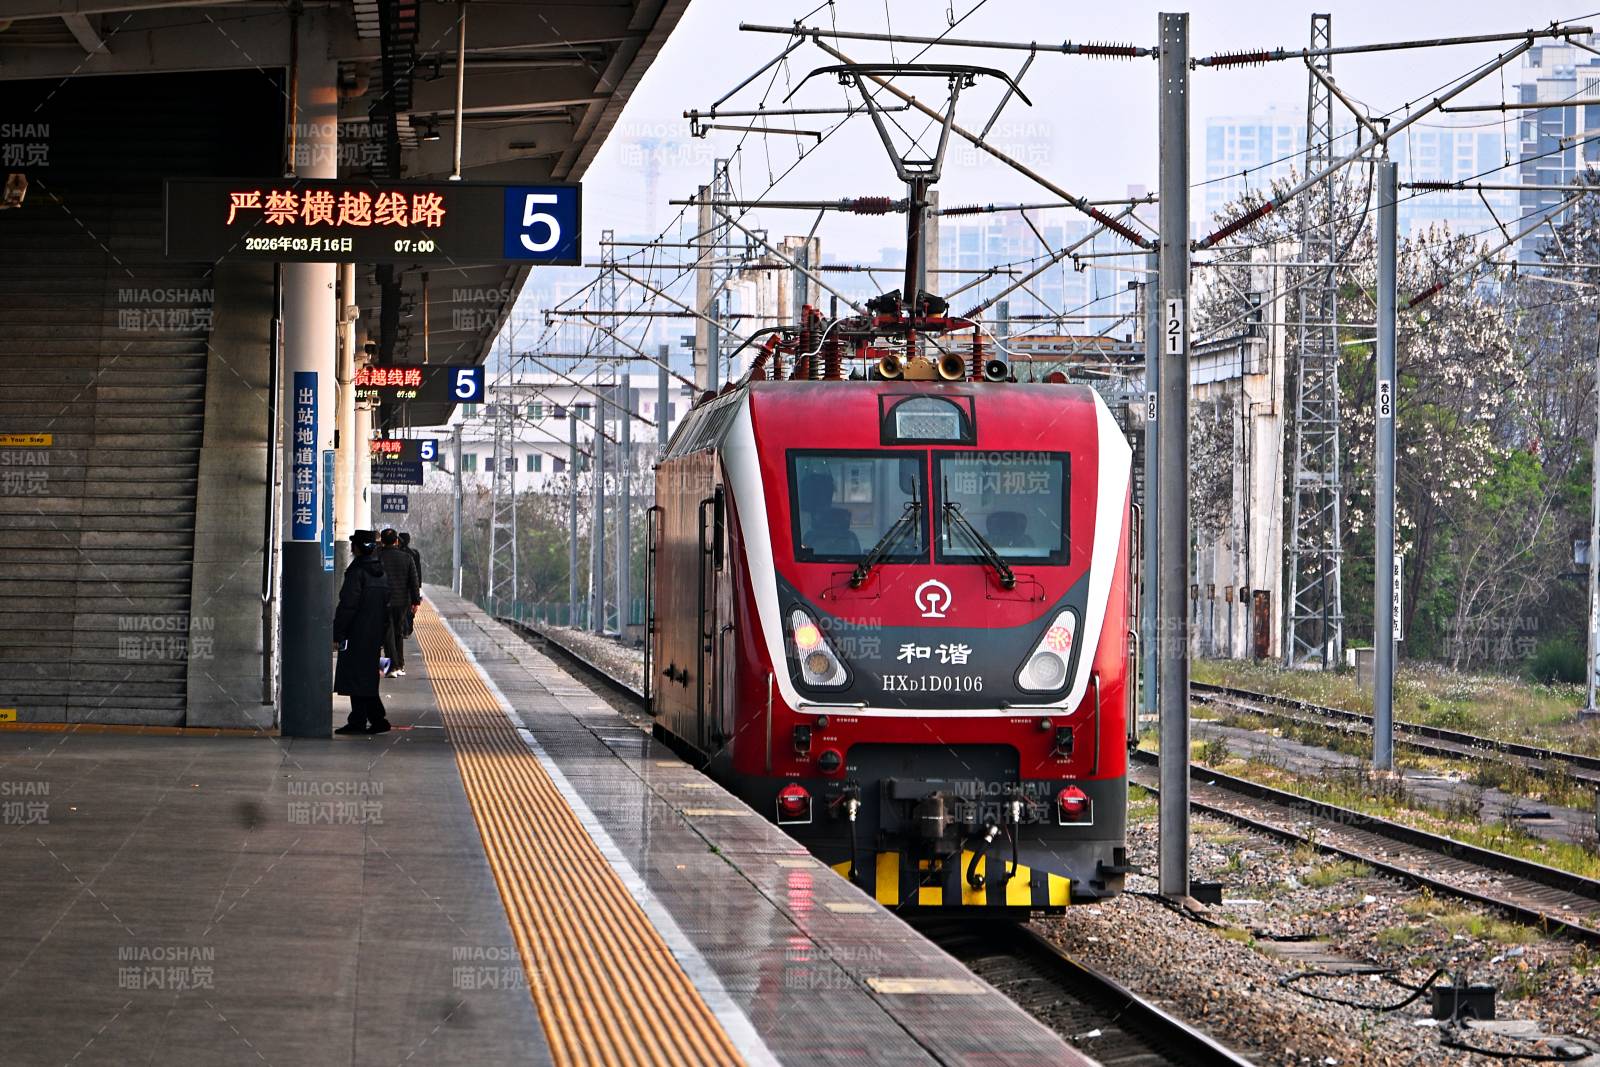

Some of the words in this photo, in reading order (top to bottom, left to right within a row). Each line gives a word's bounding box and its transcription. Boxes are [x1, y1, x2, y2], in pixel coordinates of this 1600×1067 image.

[227, 190, 446, 227] 严禁横越线路
[520, 194, 561, 252] 5
[245, 236, 353, 252] 2026年03月16日
[394, 240, 434, 252] 07:00
[1168, 303, 1181, 352] 121
[455, 369, 476, 398] 5
[296, 388, 314, 524] 出站地道往前走
[420, 441, 434, 460] 5
[897, 643, 972, 665] 和谐
[883, 675, 983, 692] HXD1D0106
